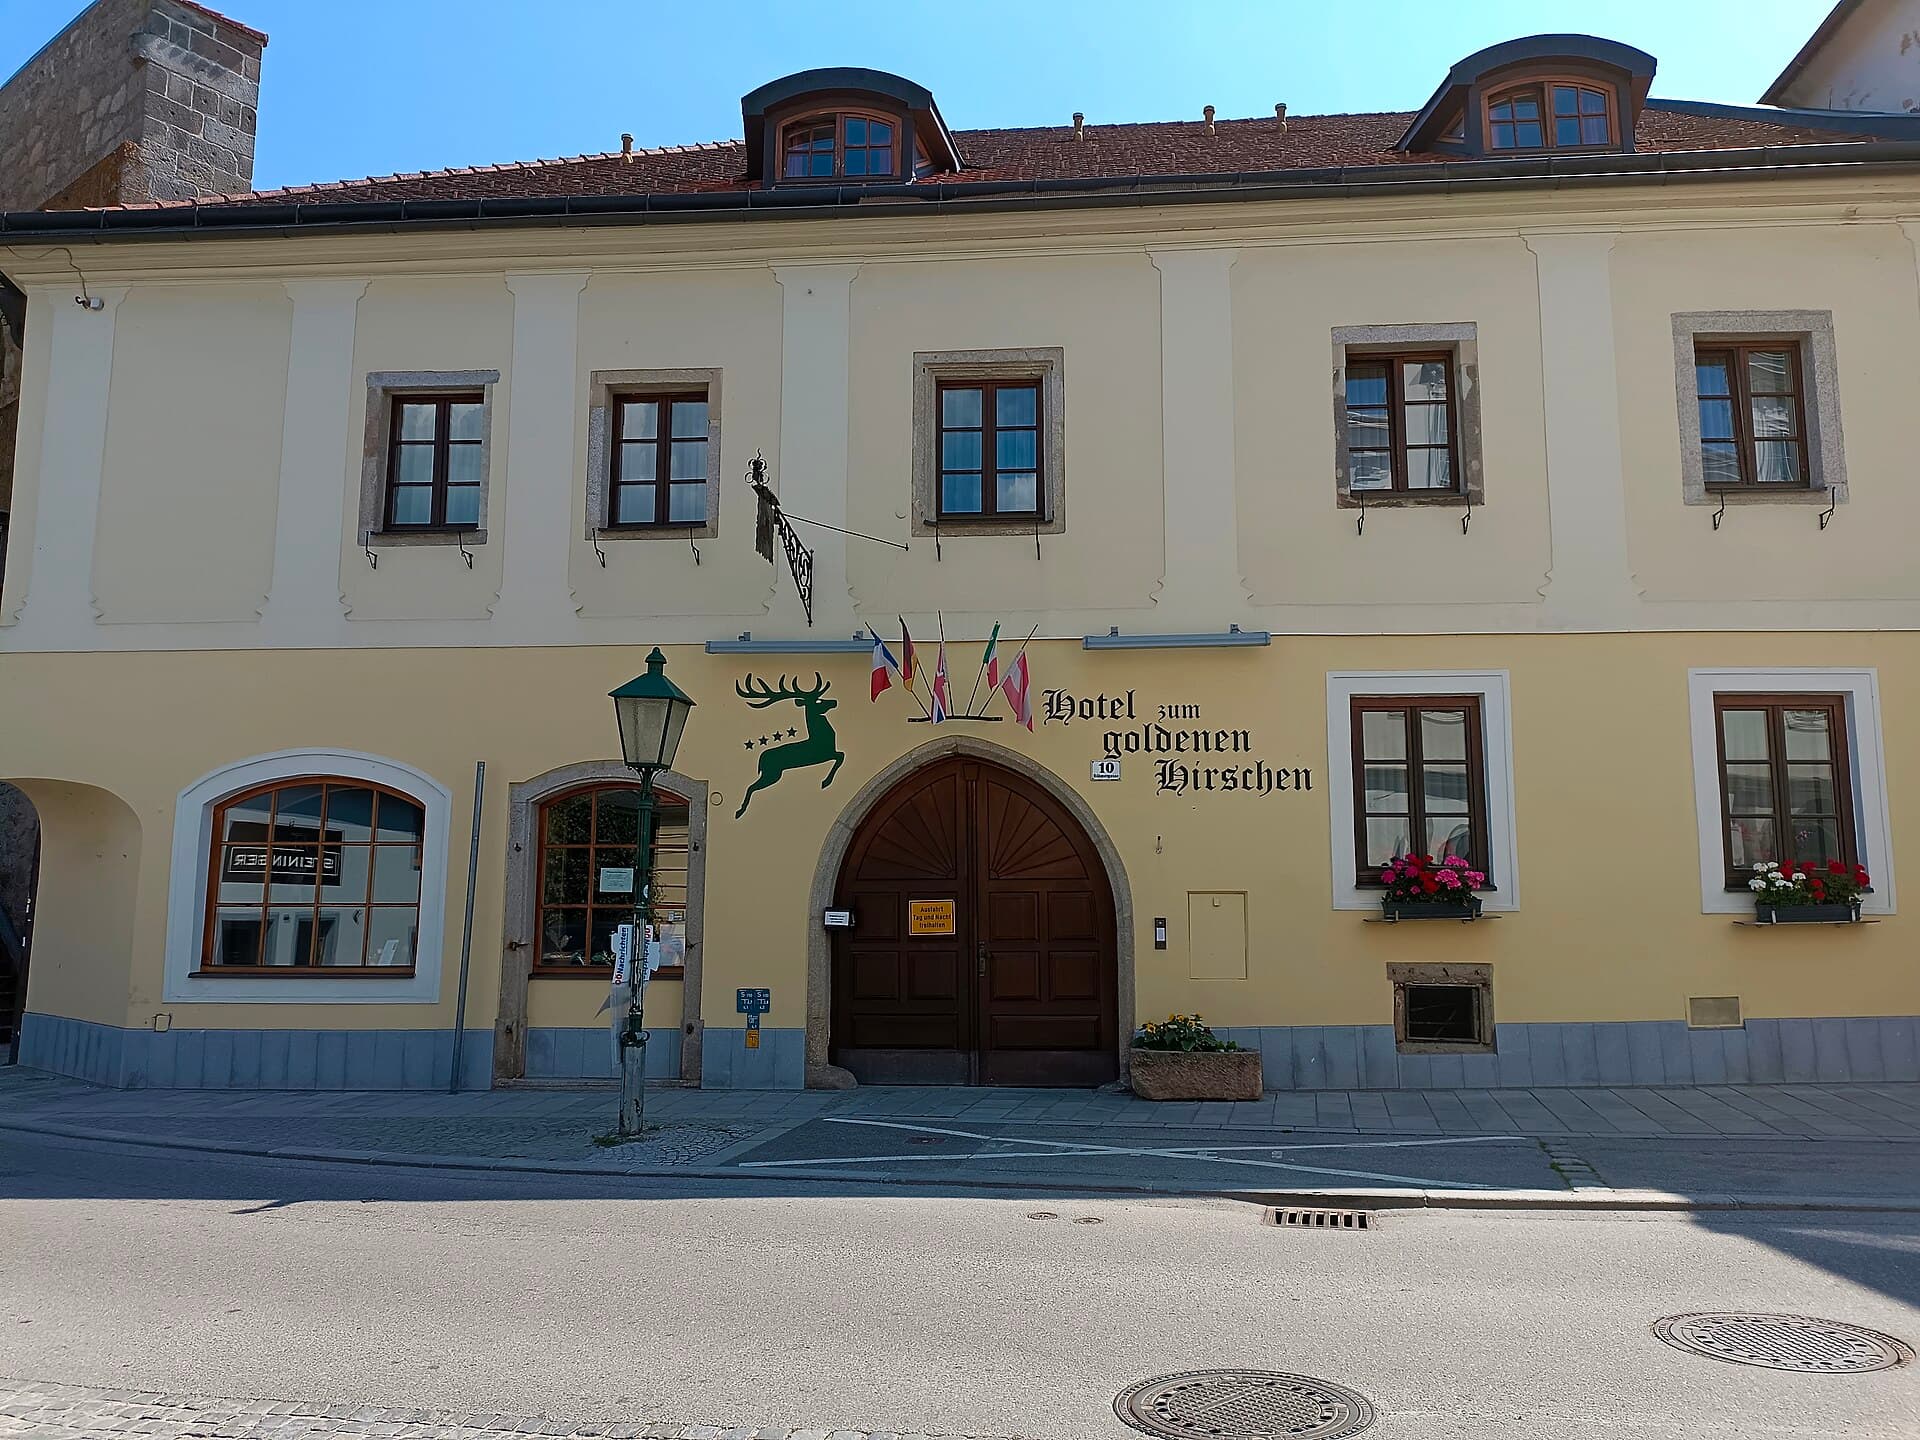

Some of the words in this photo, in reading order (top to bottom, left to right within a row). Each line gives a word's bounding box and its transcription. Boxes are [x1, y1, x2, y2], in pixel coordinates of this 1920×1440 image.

[1042, 688, 1137, 726] Hotel
[1158, 703, 1200, 722] zum
[1103, 723, 1251, 759] goldenen
[1099, 762, 1115, 774] 10
[1154, 759, 1313, 798] Hirschen
